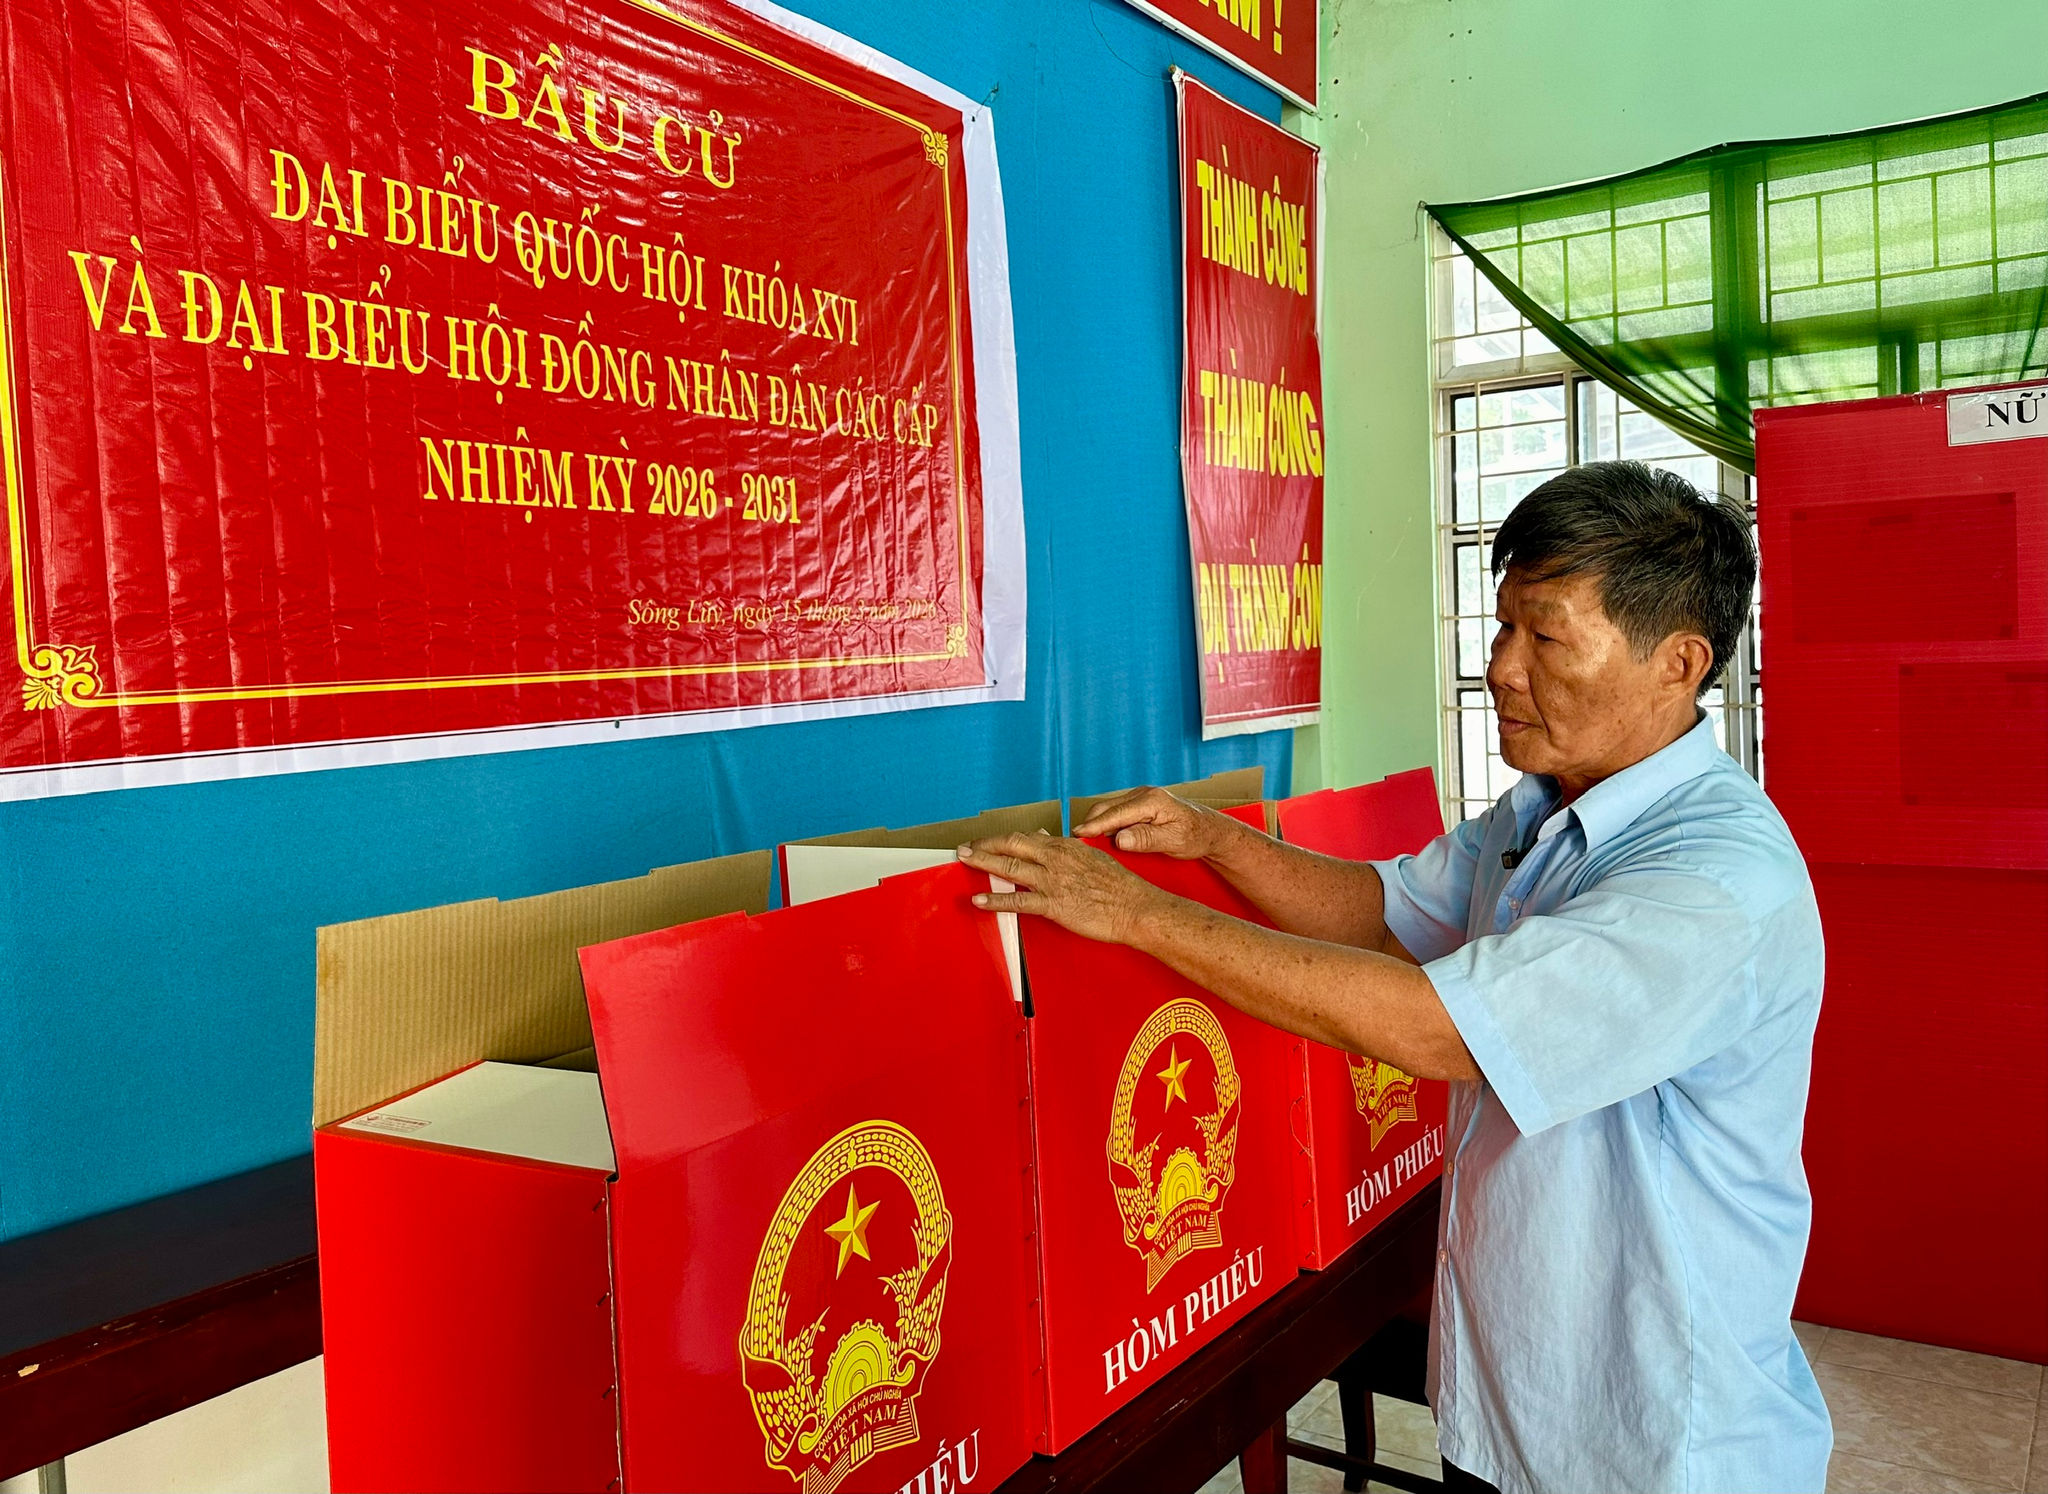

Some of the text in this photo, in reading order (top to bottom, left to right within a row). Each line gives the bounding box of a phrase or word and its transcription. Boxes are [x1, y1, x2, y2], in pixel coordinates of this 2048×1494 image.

[465, 42, 742, 190] BẦU CỬ
[269, 148, 859, 348] ĐẠI BIỂU QUỐC HỘI KHÓA XVI
[1196, 145, 1308, 296] THÀNH CÔNG
[67, 235, 939, 448] VÀ ĐẠI BIỂU HỘI ĐỒNG NHÂN DÂN CÁC CẤP
[1200, 348, 1265, 473] THÀNH
[1984, 391, 2047, 428] NỮ
[420, 426, 802, 525] NHIỆM KỲ 2026 - 2031
[628, 599, 681, 631] Sông
[733, 600, 777, 629] ngày
[781, 599, 801, 622] 15
[1228, 538, 1289, 653] THÀNH
[1185, 1213, 1207, 1230] NAM
[1345, 1123, 1444, 1227] HÒM PHIẾU
[1102, 1245, 1264, 1395] HÒM PHIẾU
[821, 1404, 898, 1464] VIỆT NAM
